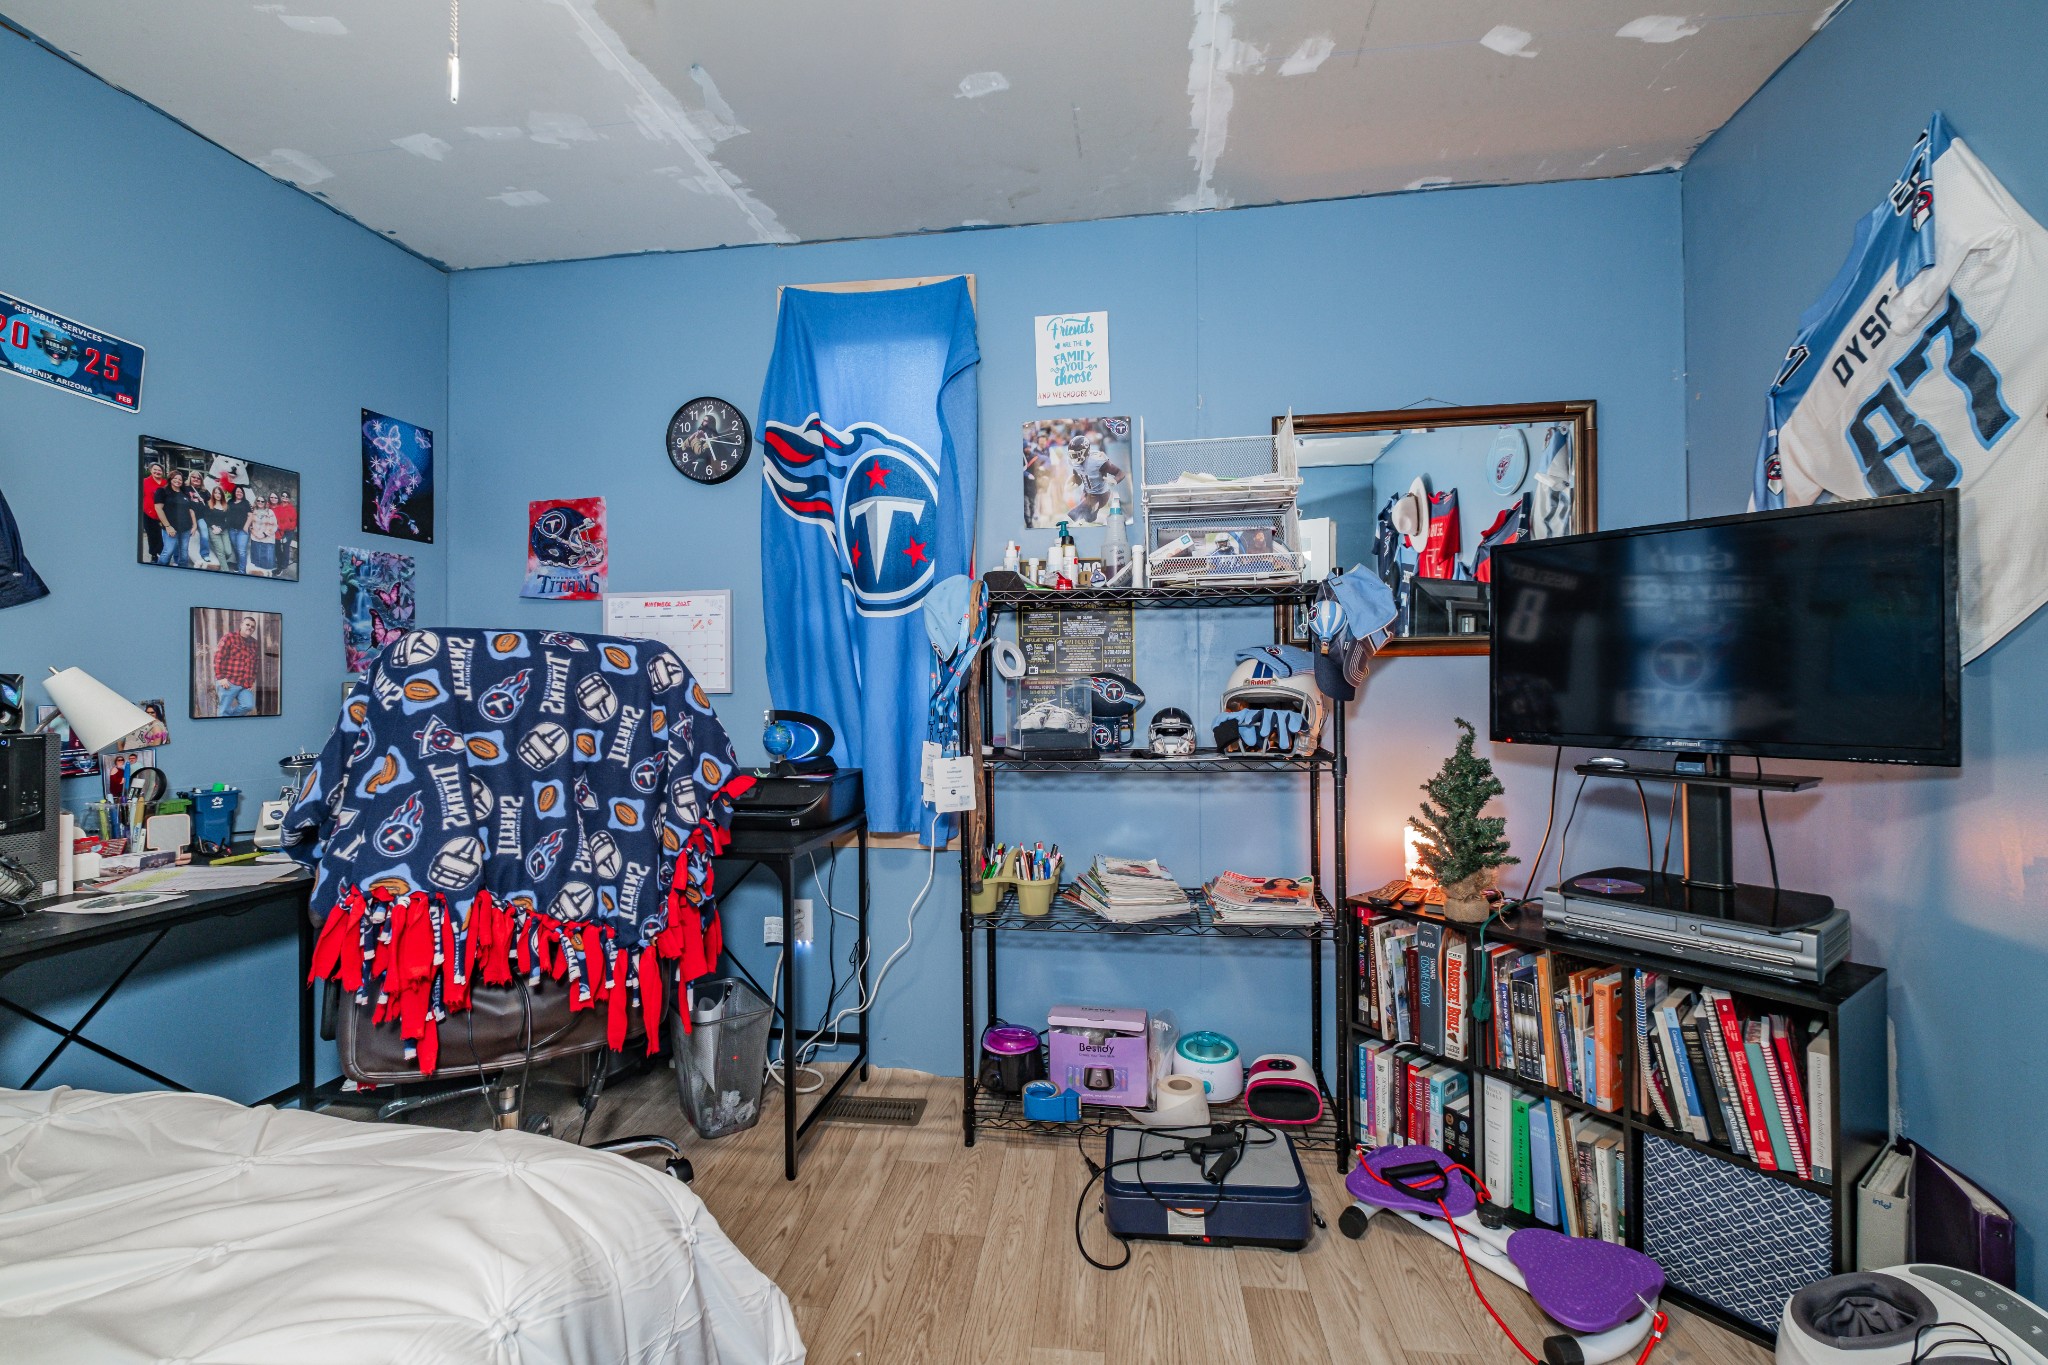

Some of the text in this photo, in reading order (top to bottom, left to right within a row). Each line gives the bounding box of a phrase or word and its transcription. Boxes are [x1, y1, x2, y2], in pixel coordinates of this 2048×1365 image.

[14, 303, 103, 342] REPUBLIC SERVICES
[1046, 315, 1094, 341] Friends
[1831, 288, 1893, 389] DYSO
[84, 347, 120, 382] 25
[1053, 350, 1095, 366] FAMILY
[1065, 362, 1084, 372] YOU
[13, 362, 93, 394] PHOENIX, ARIZONA
[1054, 366, 1092, 387] choose
[1844, 285, 2021, 498] 87
[118, 393, 132, 404] FEB
[689, 410, 699, 420] 11
[702, 404, 714, 416] 12
[720, 409, 726, 420] 1
[680, 421, 692, 433] 10
[731, 420, 739, 431] 2
[676, 437, 684, 448] 9
[734, 434, 742, 446] 3
[682, 452, 689, 463] 8
[730, 448, 738, 459] 4
[692, 462, 699, 472] 7
[705, 464, 713, 476] 6
[720, 460, 728, 471] 5
[848, 496, 926, 585] T
[536, 572, 600, 594] TITANS
[1421, 956, 1431, 1008] COSMETOLOGY
[1447, 958, 1462, 1006] BARBECUE!
[1447, 1006, 1462, 1033] BIBLE
[1746, 1094, 1757, 1116] Nursing
[1872, 1197, 1893, 1210] intel
